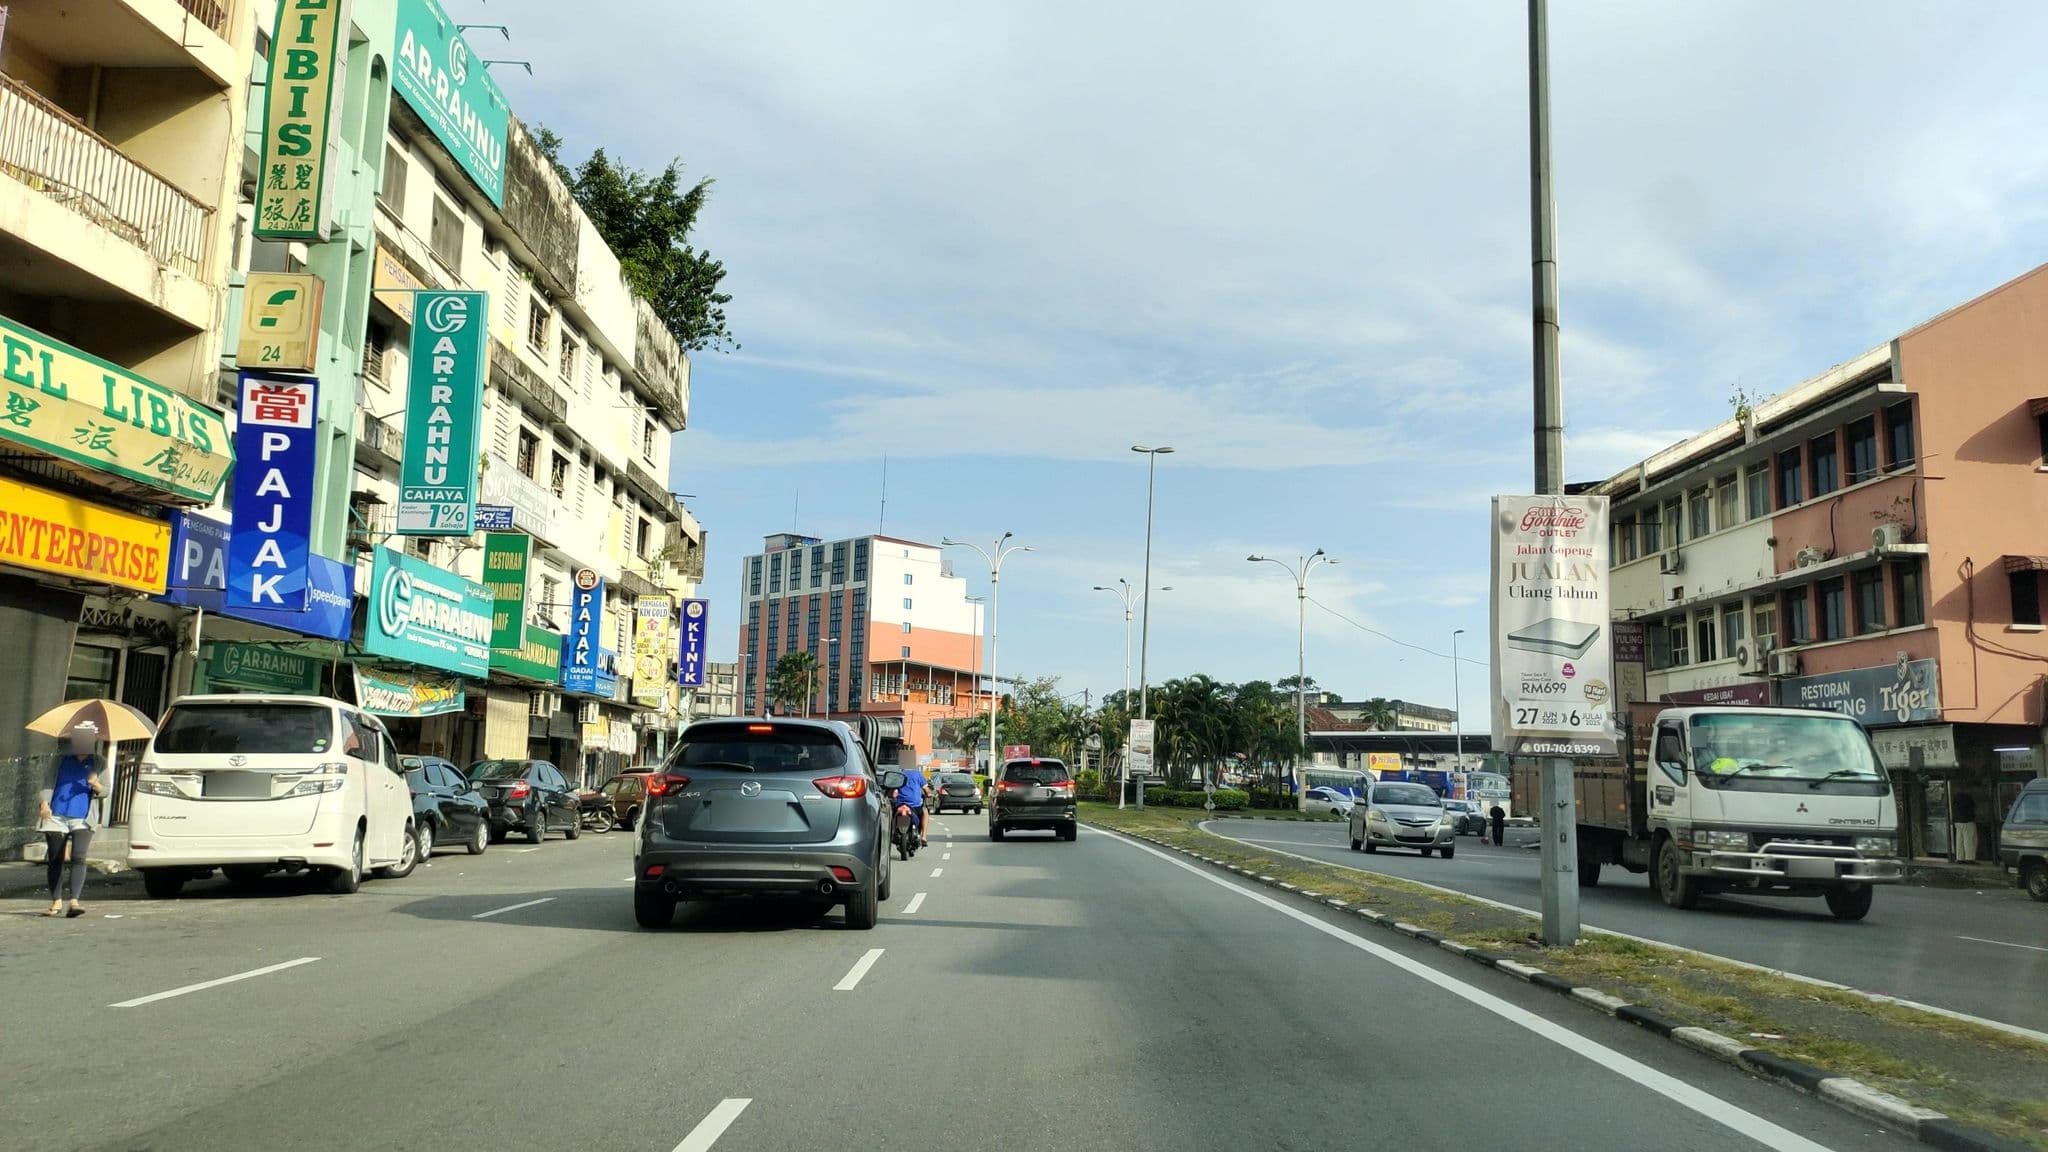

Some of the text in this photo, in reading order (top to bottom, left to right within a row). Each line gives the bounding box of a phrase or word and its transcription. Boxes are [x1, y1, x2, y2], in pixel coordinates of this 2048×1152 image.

[400, 28, 500, 171] AR-RAHNU
[469, 151, 498, 193] CAHAYA
[268, 222, 279, 230] 24
[261, 345, 281, 362] 24
[103, 374, 213, 454] LIBIS
[250, 385, 306, 423] 當
[424, 336, 457, 485] AR-RAHNU
[177, 463, 219, 488] 24 JAM
[404, 490, 464, 501] CAHAYA
[251, 432, 291, 605] PAJAK
[429, 504, 465, 528] 1%
[1520, 506, 1586, 532] Goodnite
[1538, 529, 1578, 537] OUTLET
[489, 551, 523, 570] RESTORAN
[1517, 544, 1593, 557] Jalan Gopeng
[1511, 562, 1598, 583] JUALAN
[313, 588, 351, 608] speedpawn
[1509, 585, 1598, 601] Ulang Tahun
[493, 612, 508, 631] ARIF
[652, 607, 668, 618] GOLD
[575, 593, 592, 665] PAJAK
[241, 649, 304, 675] AR-RAHNU
[684, 622, 700, 683] KLINIK
[570, 666, 593, 674] GADAI
[1521, 682, 1567, 694] RM699
[1703, 690, 1734, 702] KEDAI UBAT
[1801, 680, 1850, 700] RESTORAN
[1880, 681, 1930, 723] Tiger
[1516, 708, 1538, 724] 27
[1570, 709, 1580, 726] 6
[1582, 712, 1603, 720] JULAI
[1574, 744, 1600, 754] 8399
